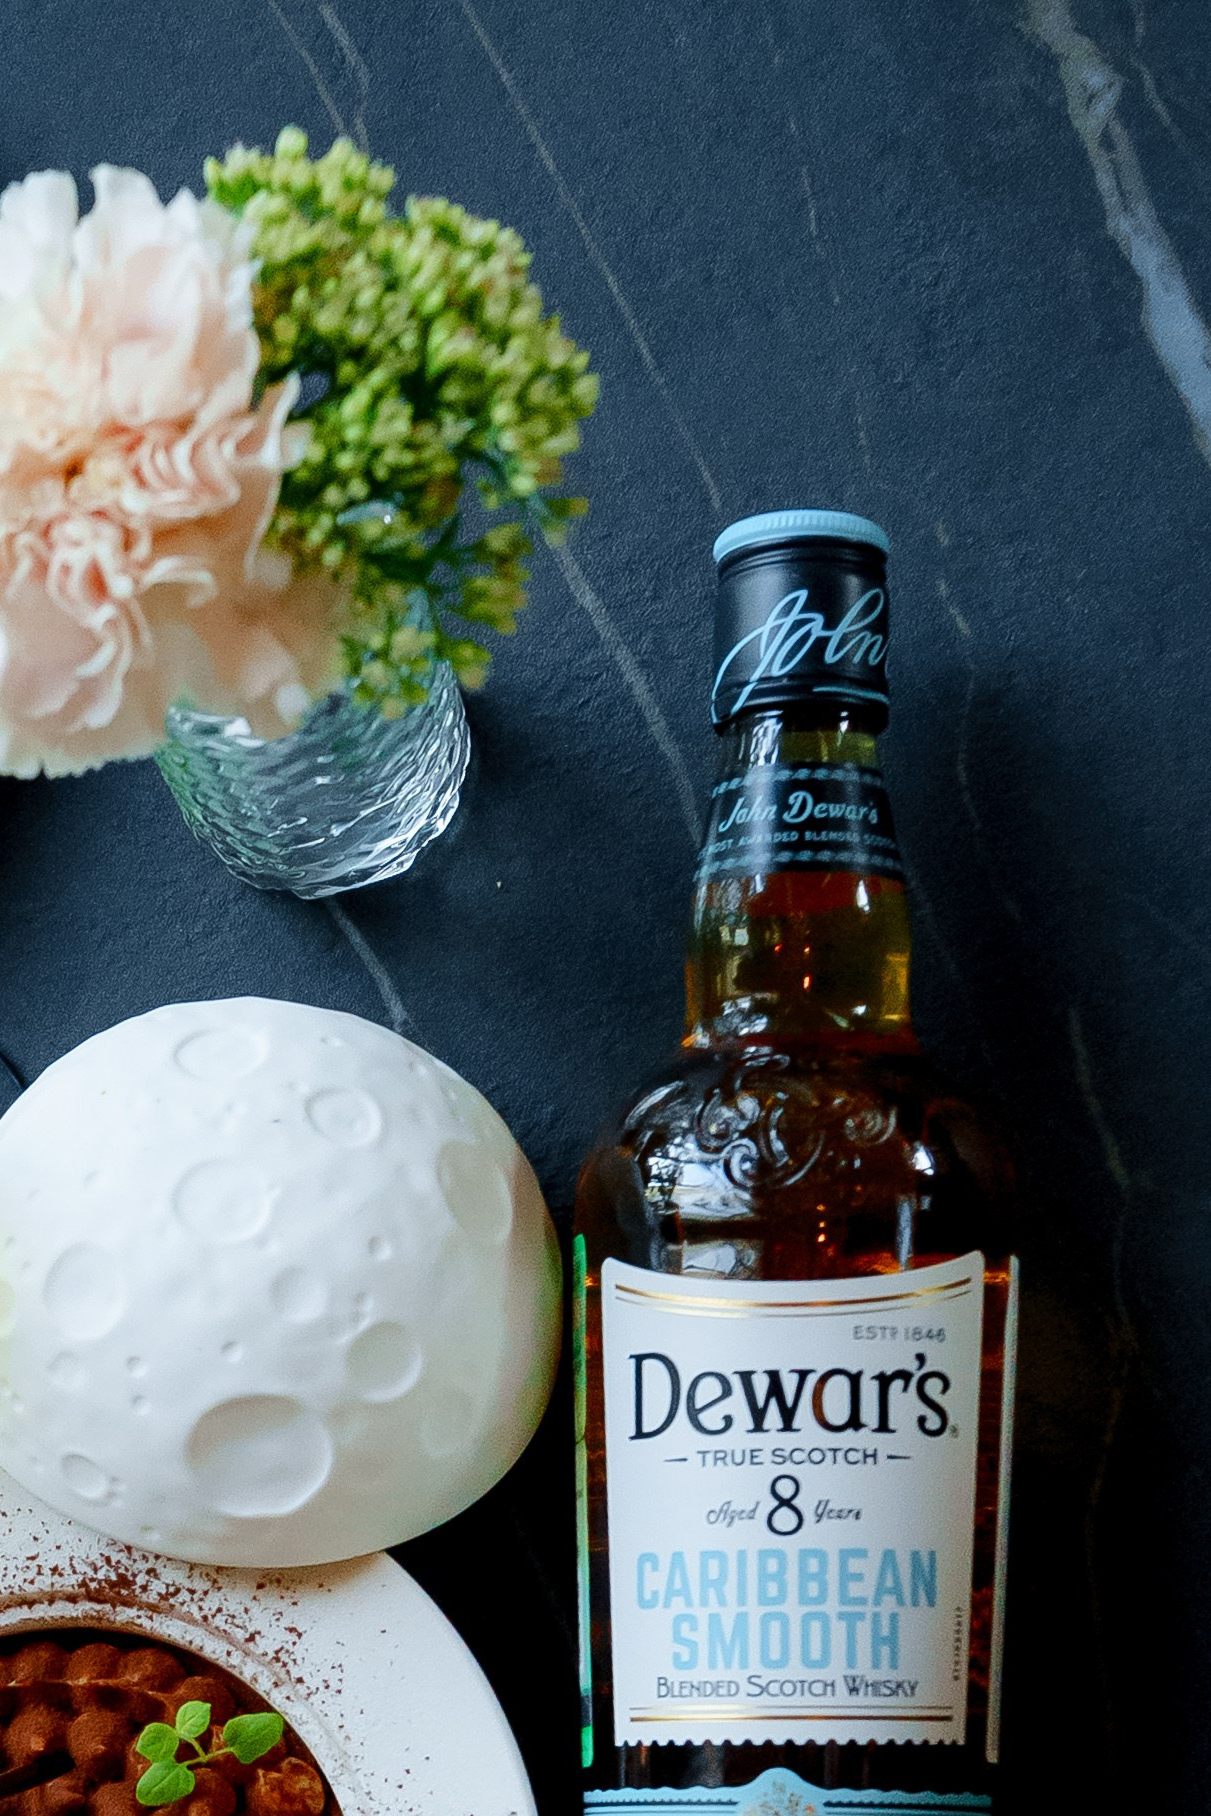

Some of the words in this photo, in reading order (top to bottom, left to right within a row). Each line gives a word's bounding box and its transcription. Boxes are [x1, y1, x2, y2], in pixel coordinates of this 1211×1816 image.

[711, 588, 889, 724] John
[718, 796, 777, 832] John
[782, 790, 879, 824] Dewar's
[903, 1326, 946, 1342] 1846
[629, 1352, 951, 1440] Dewar's
[697, 1449, 764, 1467] TRUE
[771, 1447, 878, 1466] SCOTCH
[706, 1500, 761, 1528] Aged
[766, 1474, 804, 1537] 8
[814, 1499, 862, 1524] Years
[636, 1548, 938, 1610] CARIBBEAN
[672, 1611, 900, 1670] SMOOTH
[657, 1676, 739, 1698] BLENDED
[746, 1674, 836, 1697] SCOTCH
[843, 1674, 919, 1698] WHISKY
